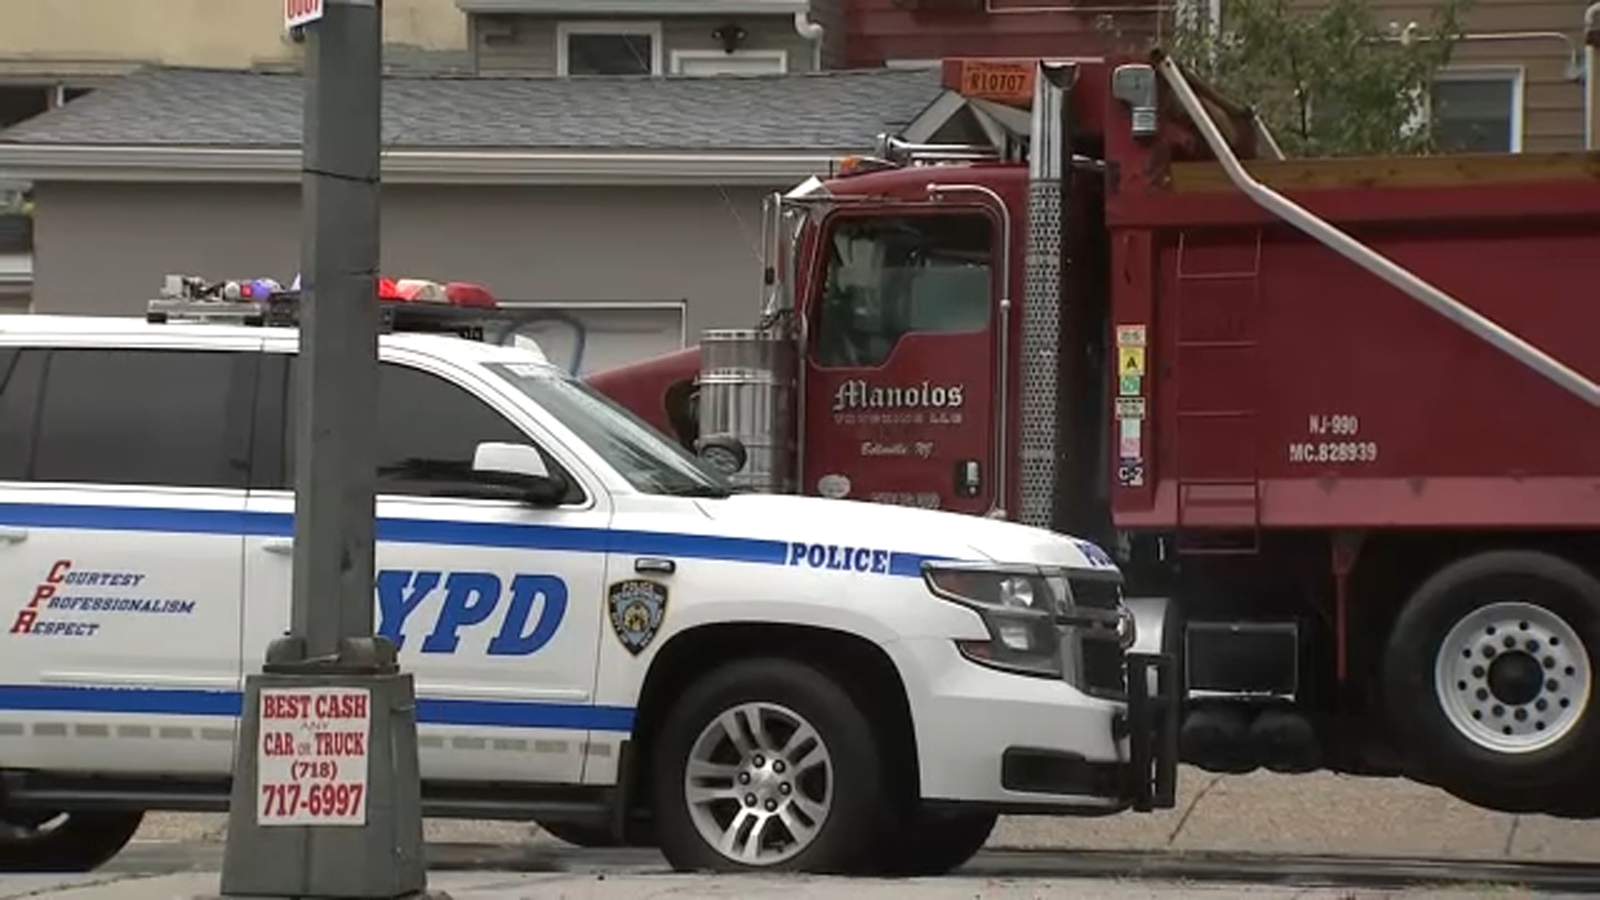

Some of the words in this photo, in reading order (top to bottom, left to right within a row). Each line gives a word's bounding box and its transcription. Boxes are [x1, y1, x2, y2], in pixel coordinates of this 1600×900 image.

[833, 379, 963, 411] Manolos
[1309, 414, 1358, 435] NJ-990
[790, 542, 888, 574] POLICE
[375, 570, 568, 656] YPD
[263, 695, 311, 718] BEST
[315, 695, 367, 718] CASH
[263, 732, 294, 756] CAR
[315, 732, 365, 756] TRUCK
[291, 760, 338, 780] (718)
[262, 784, 363, 816] 717-6997
